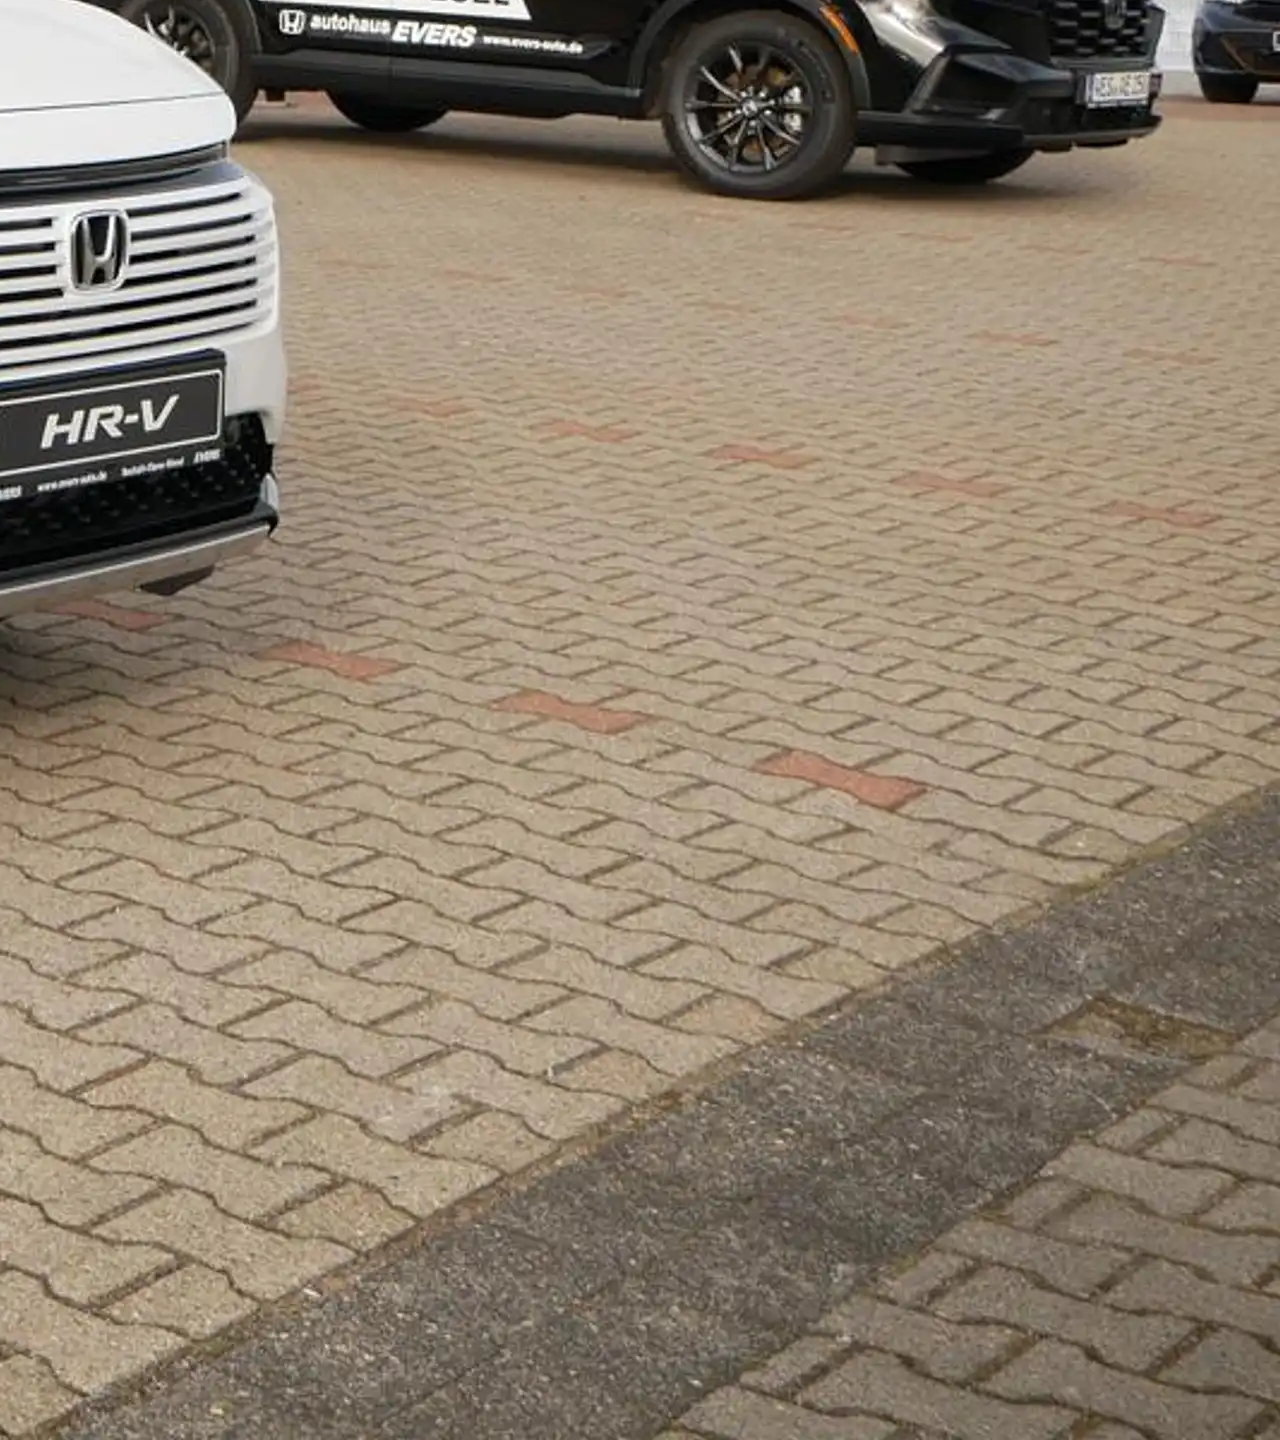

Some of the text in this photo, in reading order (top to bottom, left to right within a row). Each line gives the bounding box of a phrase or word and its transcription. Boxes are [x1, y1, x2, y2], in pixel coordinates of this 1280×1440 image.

[309, 12, 391, 35] autohaus
[391, 20, 479, 48] EVERS
[40, 393, 180, 450] HR-V
